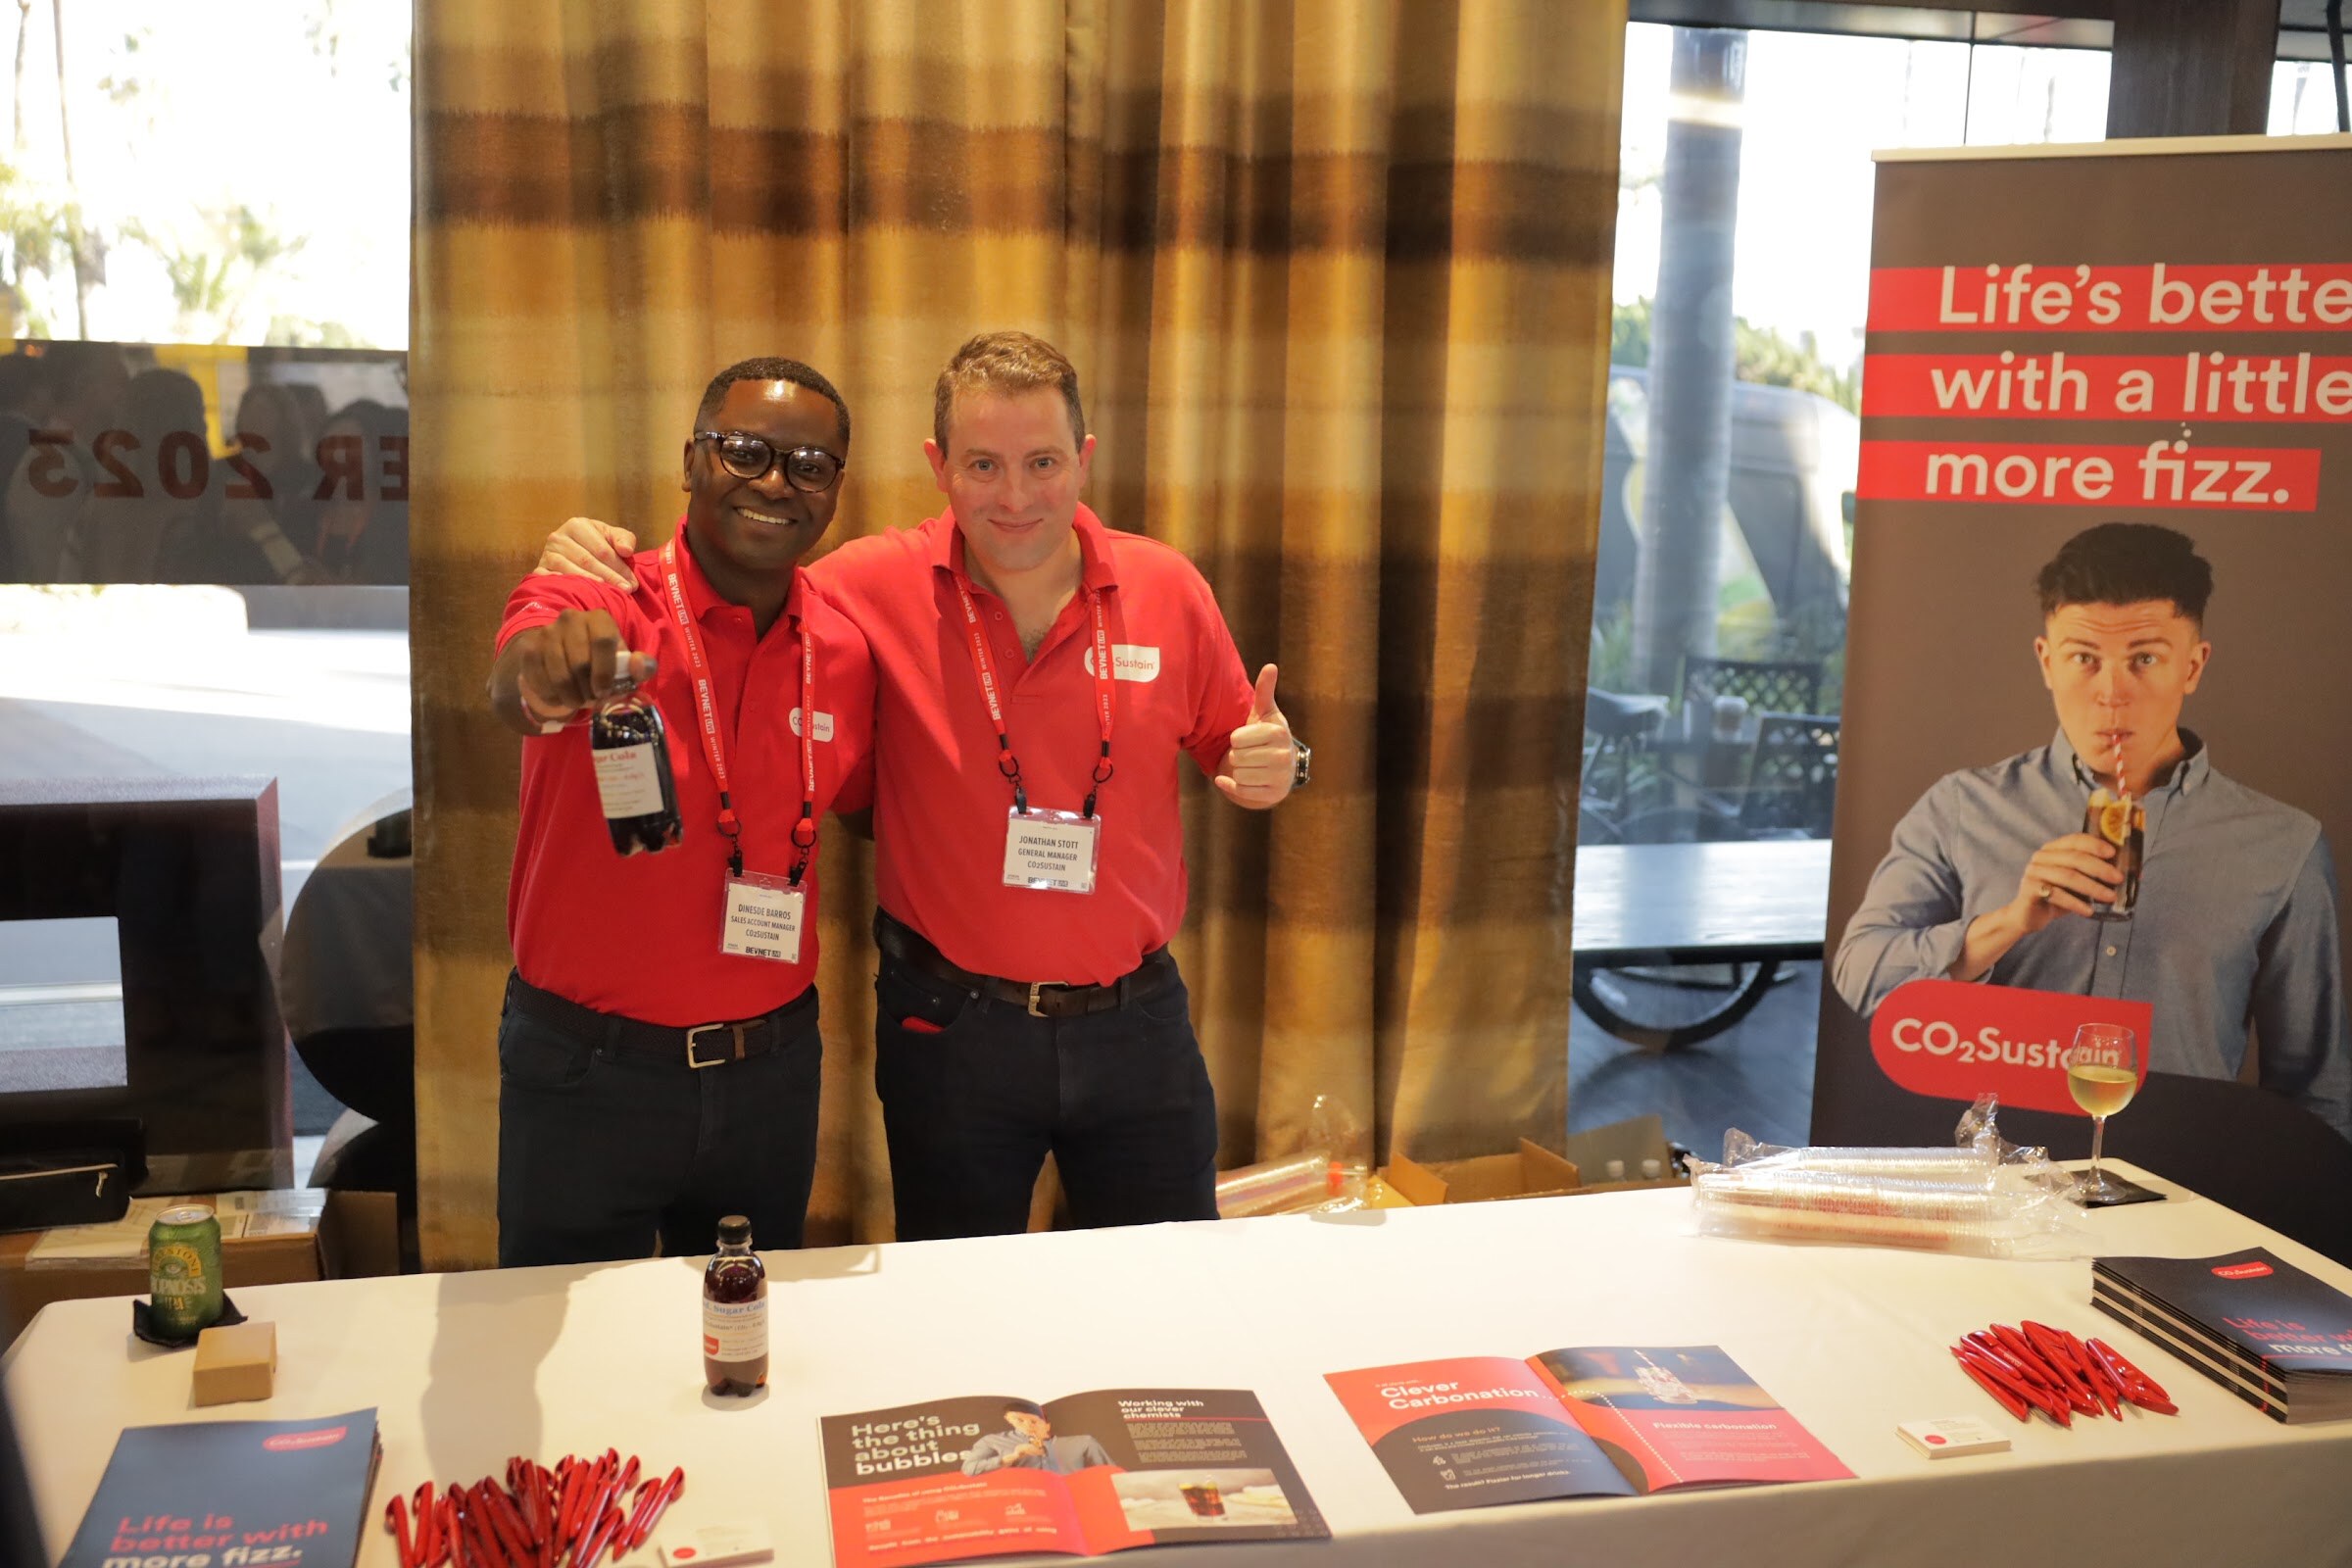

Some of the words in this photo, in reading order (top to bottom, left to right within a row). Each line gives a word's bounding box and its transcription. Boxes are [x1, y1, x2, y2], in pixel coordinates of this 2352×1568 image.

[1939, 263, 2123, 325] Life’s
[1931, 351, 2089, 412] with
[2115, 369, 2154, 413] a
[2182, 351, 2352, 416] little
[1926, 454, 2114, 499] more
[2138, 439, 2290, 505] fizz.
[684, 627, 697, 652] WINTER
[692, 652, 702, 667] 2023
[710, 737, 721, 762] WINTER
[716, 762, 725, 779] 2023
[1019, 836, 1056, 847] JONATHAN
[1057, 840, 1078, 849] STOTT
[1018, 849, 1045, 858] GENERAL
[1048, 852, 1078, 860] MANAGER
[1027, 861, 1066, 871] CO2SUSTAIN
[766, 908, 792, 920] BARROS
[731, 916, 747, 925] SALES
[747, 919, 770, 928] ACCOUNT
[772, 922, 796, 931] MANAGER
[746, 929, 780, 941] CO2SUSTAIN
[746, 947, 771, 956] BEVNET
[713, 1305, 745, 1315] Sugar
[747, 1300, 765, 1311] Cola
[2222, 1317, 2278, 1331] Life
[2242, 1329, 2328, 1343] better
[2268, 1344, 2341, 1355] more
[1381, 1381, 1458, 1398] Clever
[1389, 1388, 1539, 1409] Carbonation
[851, 1415, 941, 1438] Here’s
[851, 1432, 899, 1450] the
[906, 1422, 980, 1441] thing
[855, 1442, 939, 1462] about
[118, 1514, 192, 1535] Life
[203, 1513, 233, 1531] is
[110, 1533, 235, 1552] better
[243, 1519, 328, 1546] with
[102, 1552, 212, 1568] more
[221, 1544, 303, 1567] fizz.
